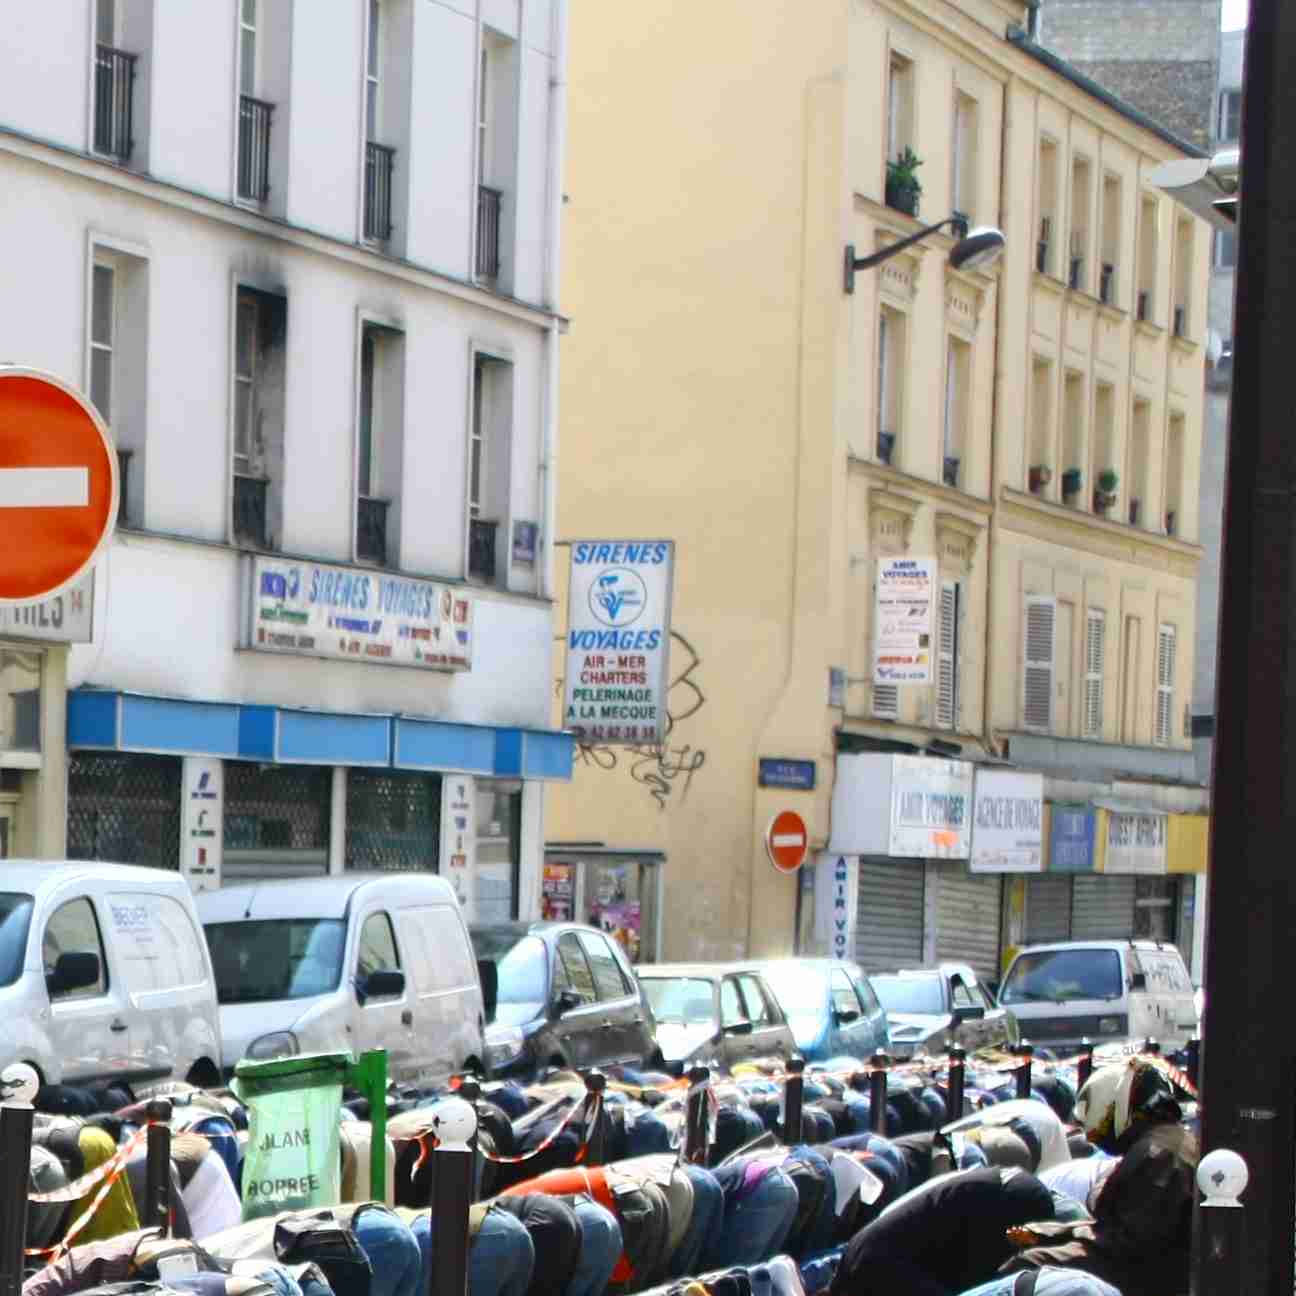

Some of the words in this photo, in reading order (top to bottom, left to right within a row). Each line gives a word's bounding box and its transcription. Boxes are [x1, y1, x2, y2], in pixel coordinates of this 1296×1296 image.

[573, 543, 668, 565] SIRENES
[568, 630, 662, 652] VOYAGES
[579, 671, 648, 685] CHARTERS
[579, 706, 596, 719] LA
[601, 706, 657, 720] MECQUE
